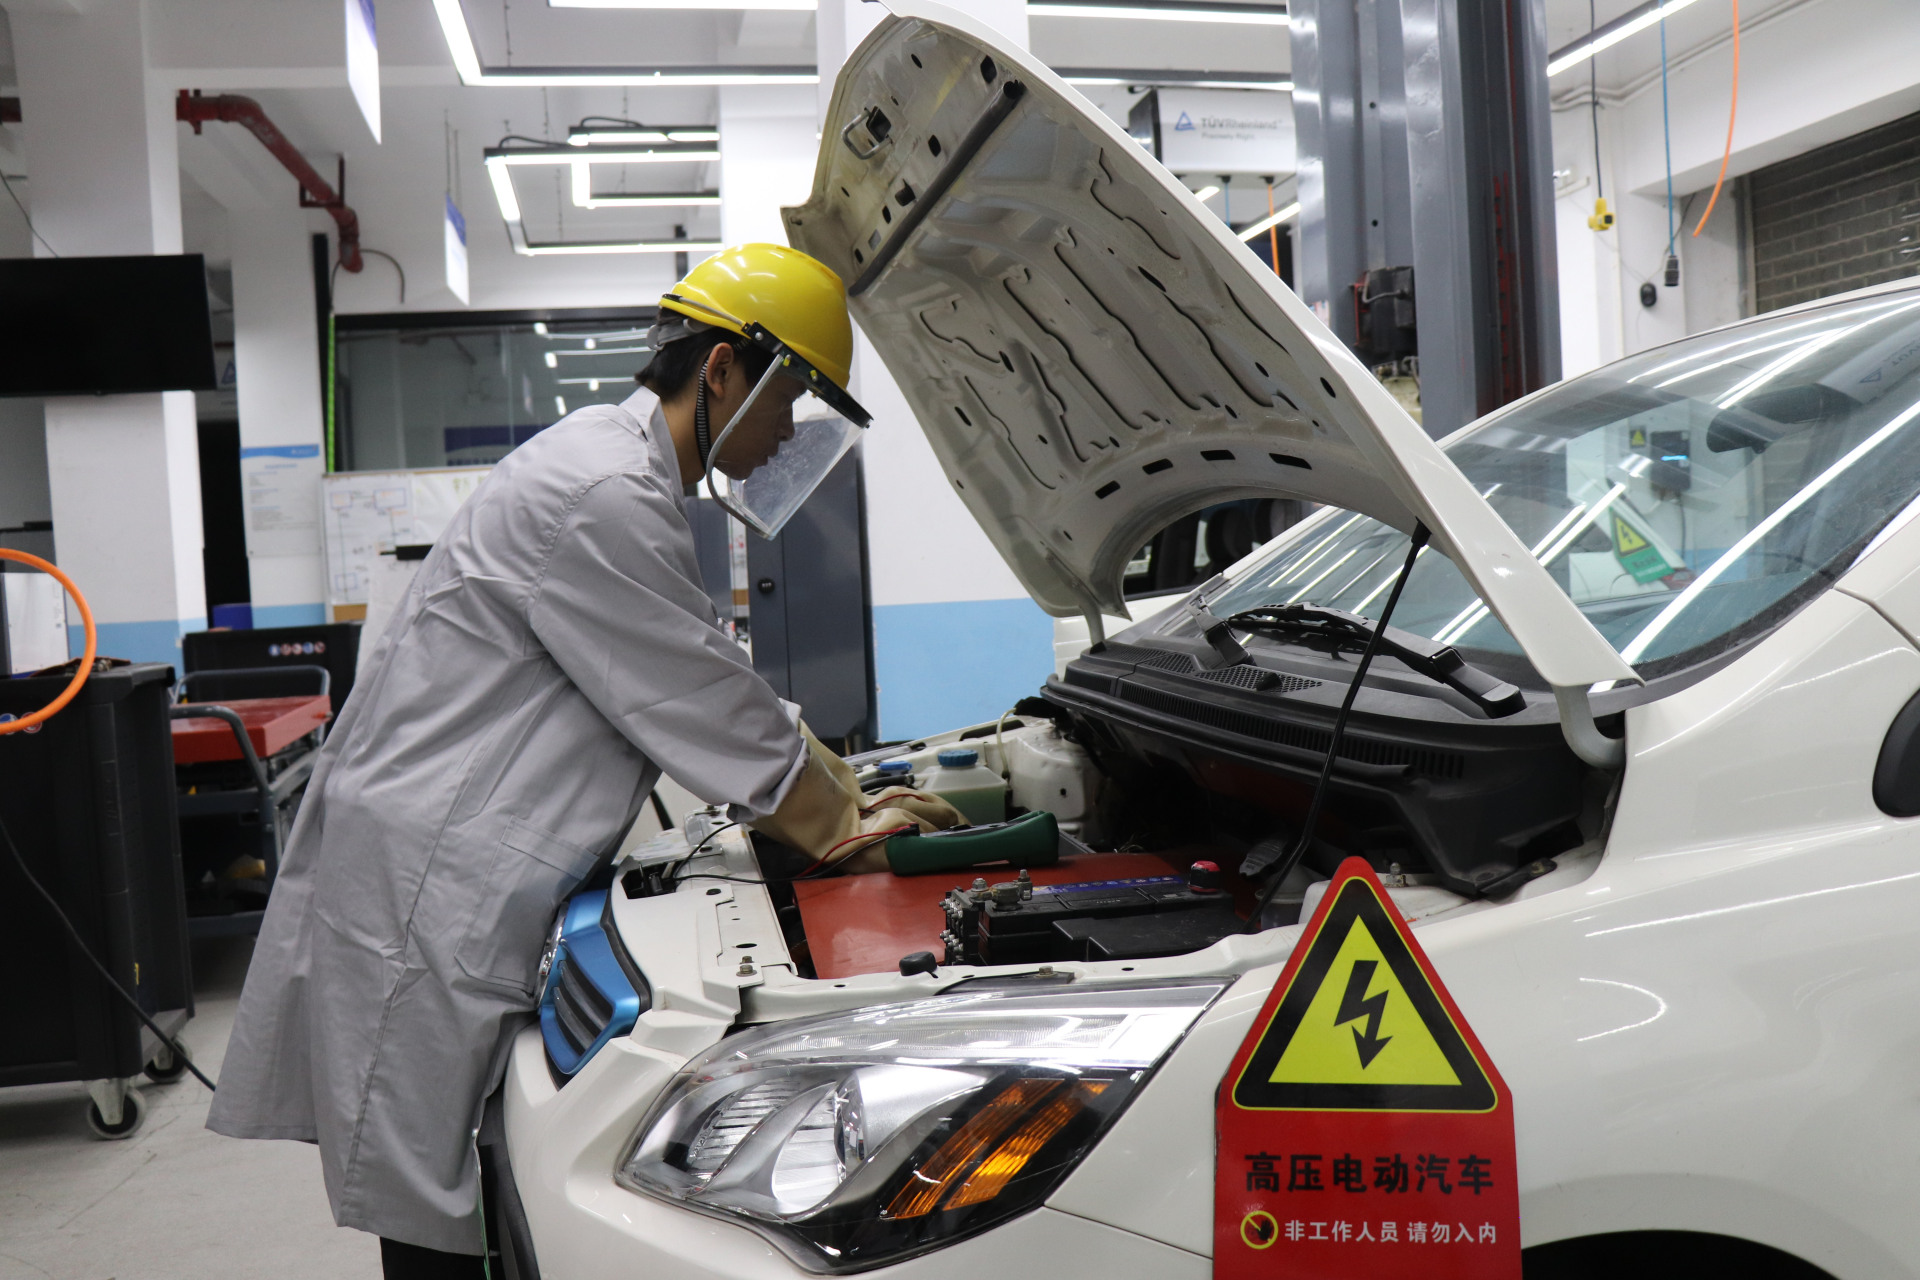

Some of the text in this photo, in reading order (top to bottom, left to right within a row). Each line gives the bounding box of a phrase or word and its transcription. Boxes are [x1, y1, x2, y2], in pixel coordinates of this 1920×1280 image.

[1245, 1152, 1494, 1195] 高压电动汽车
[1285, 1220, 1497, 1244] 非工作人员 请勿入内
